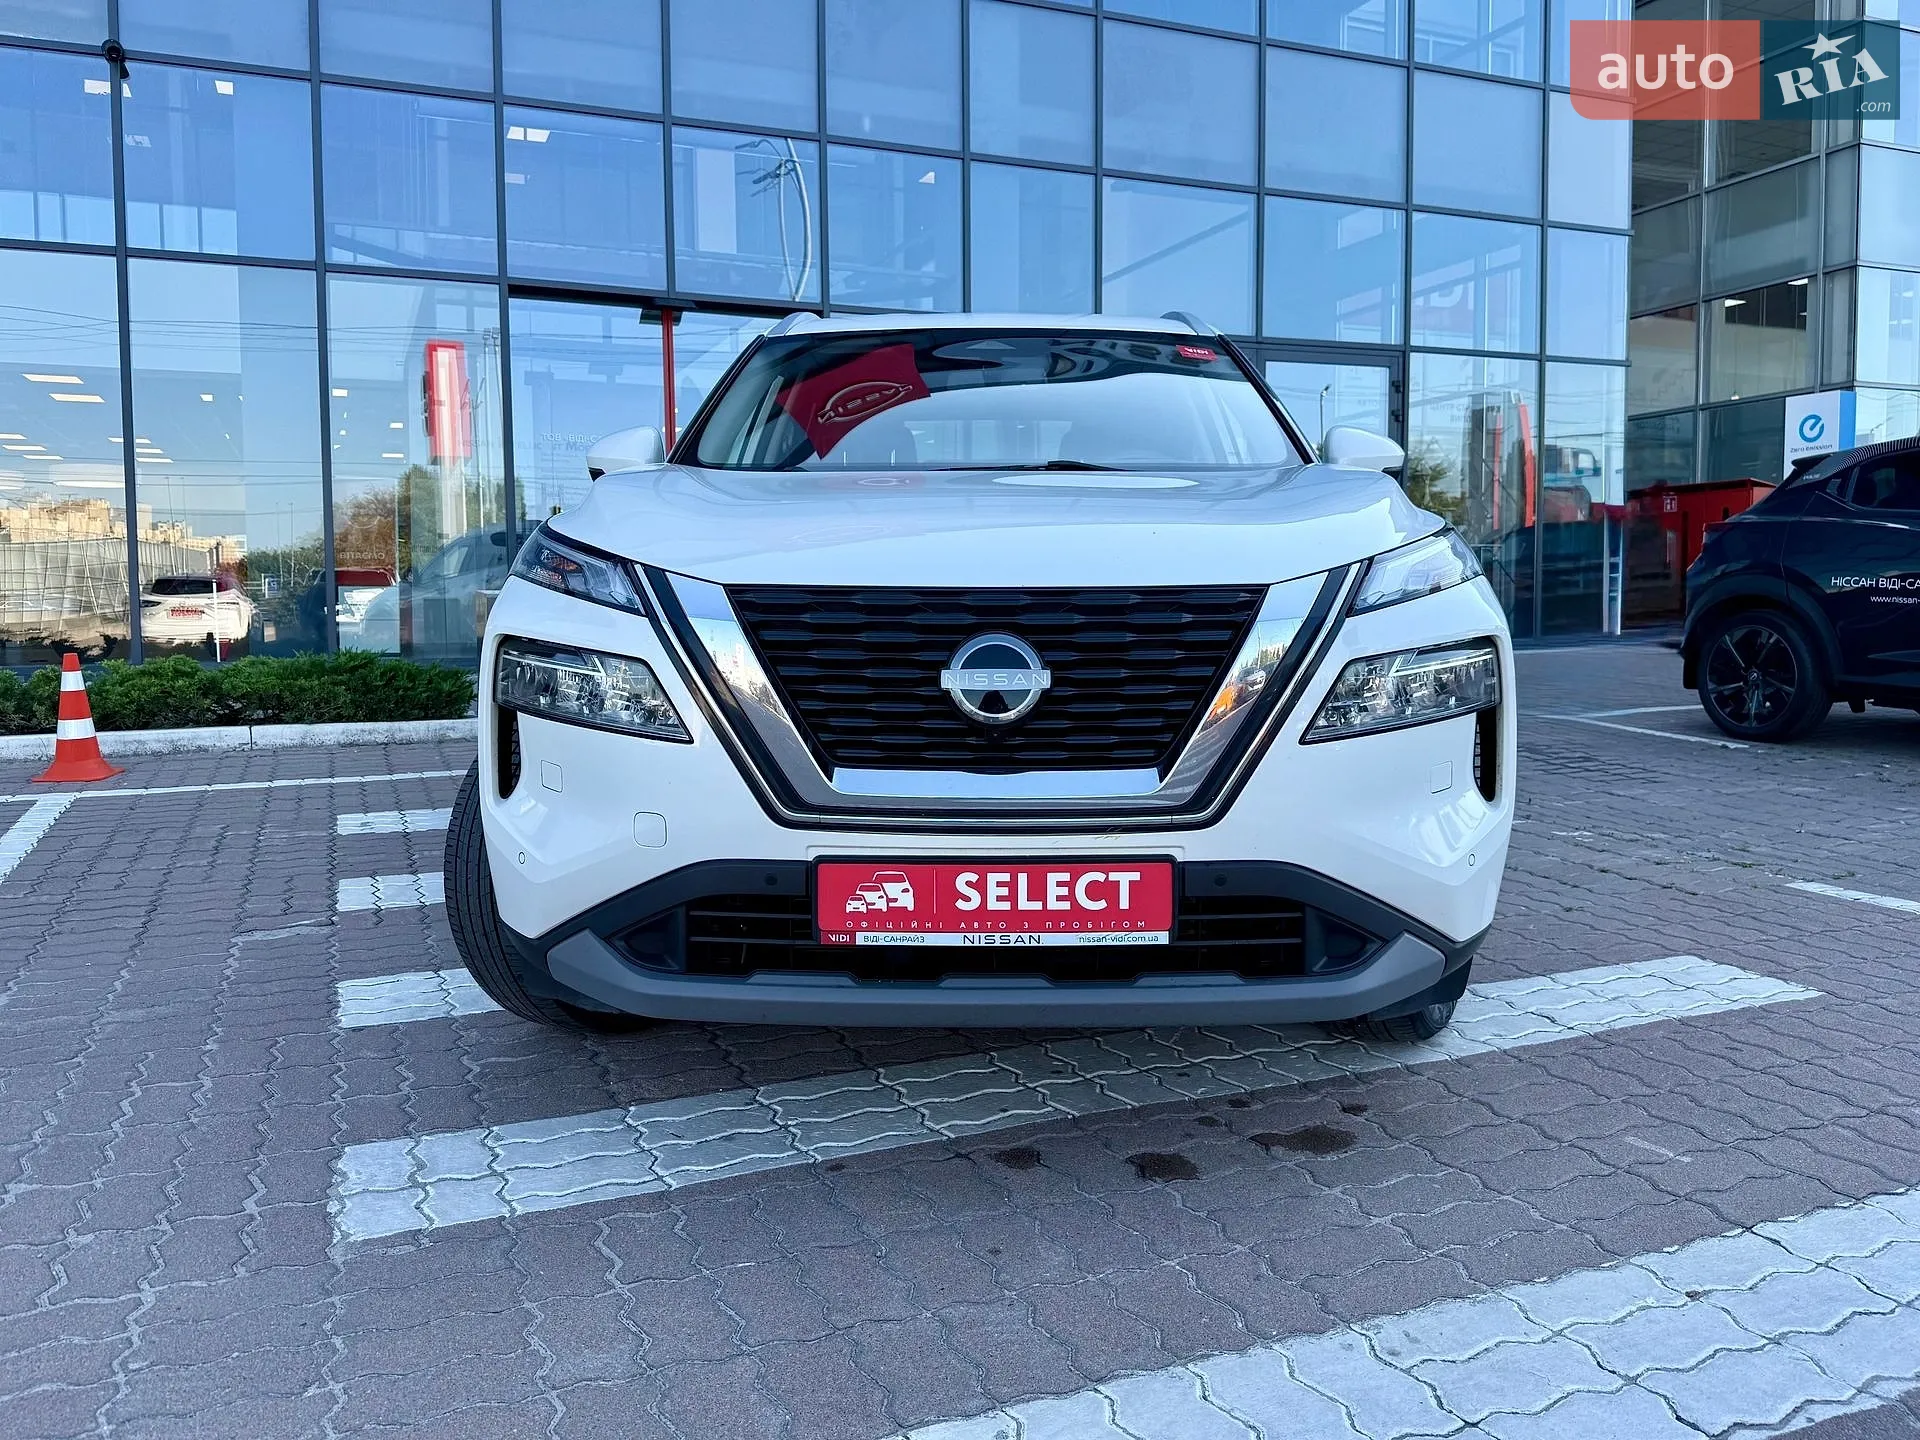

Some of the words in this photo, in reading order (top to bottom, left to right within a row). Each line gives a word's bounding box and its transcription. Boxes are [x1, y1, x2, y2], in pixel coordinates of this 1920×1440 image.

[1831, 576, 1876, 588] НІССАН
[944, 673, 1047, 686] NISSAN
[954, 871, 1141, 911] SELECT
[846, 920, 943, 930] ОФІЦІЙНІ
[959, 921, 1007, 929] АВТО
[1045, 921, 1145, 929] ПРОБІГОМ
[828, 933, 850, 942] VIDI
[863, 933, 925, 943] ВІДІ-САНРАЙЗ
[963, 934, 1042, 945] NISSAN
[1078, 934, 1159, 944] nissan-vidi.com.ua
